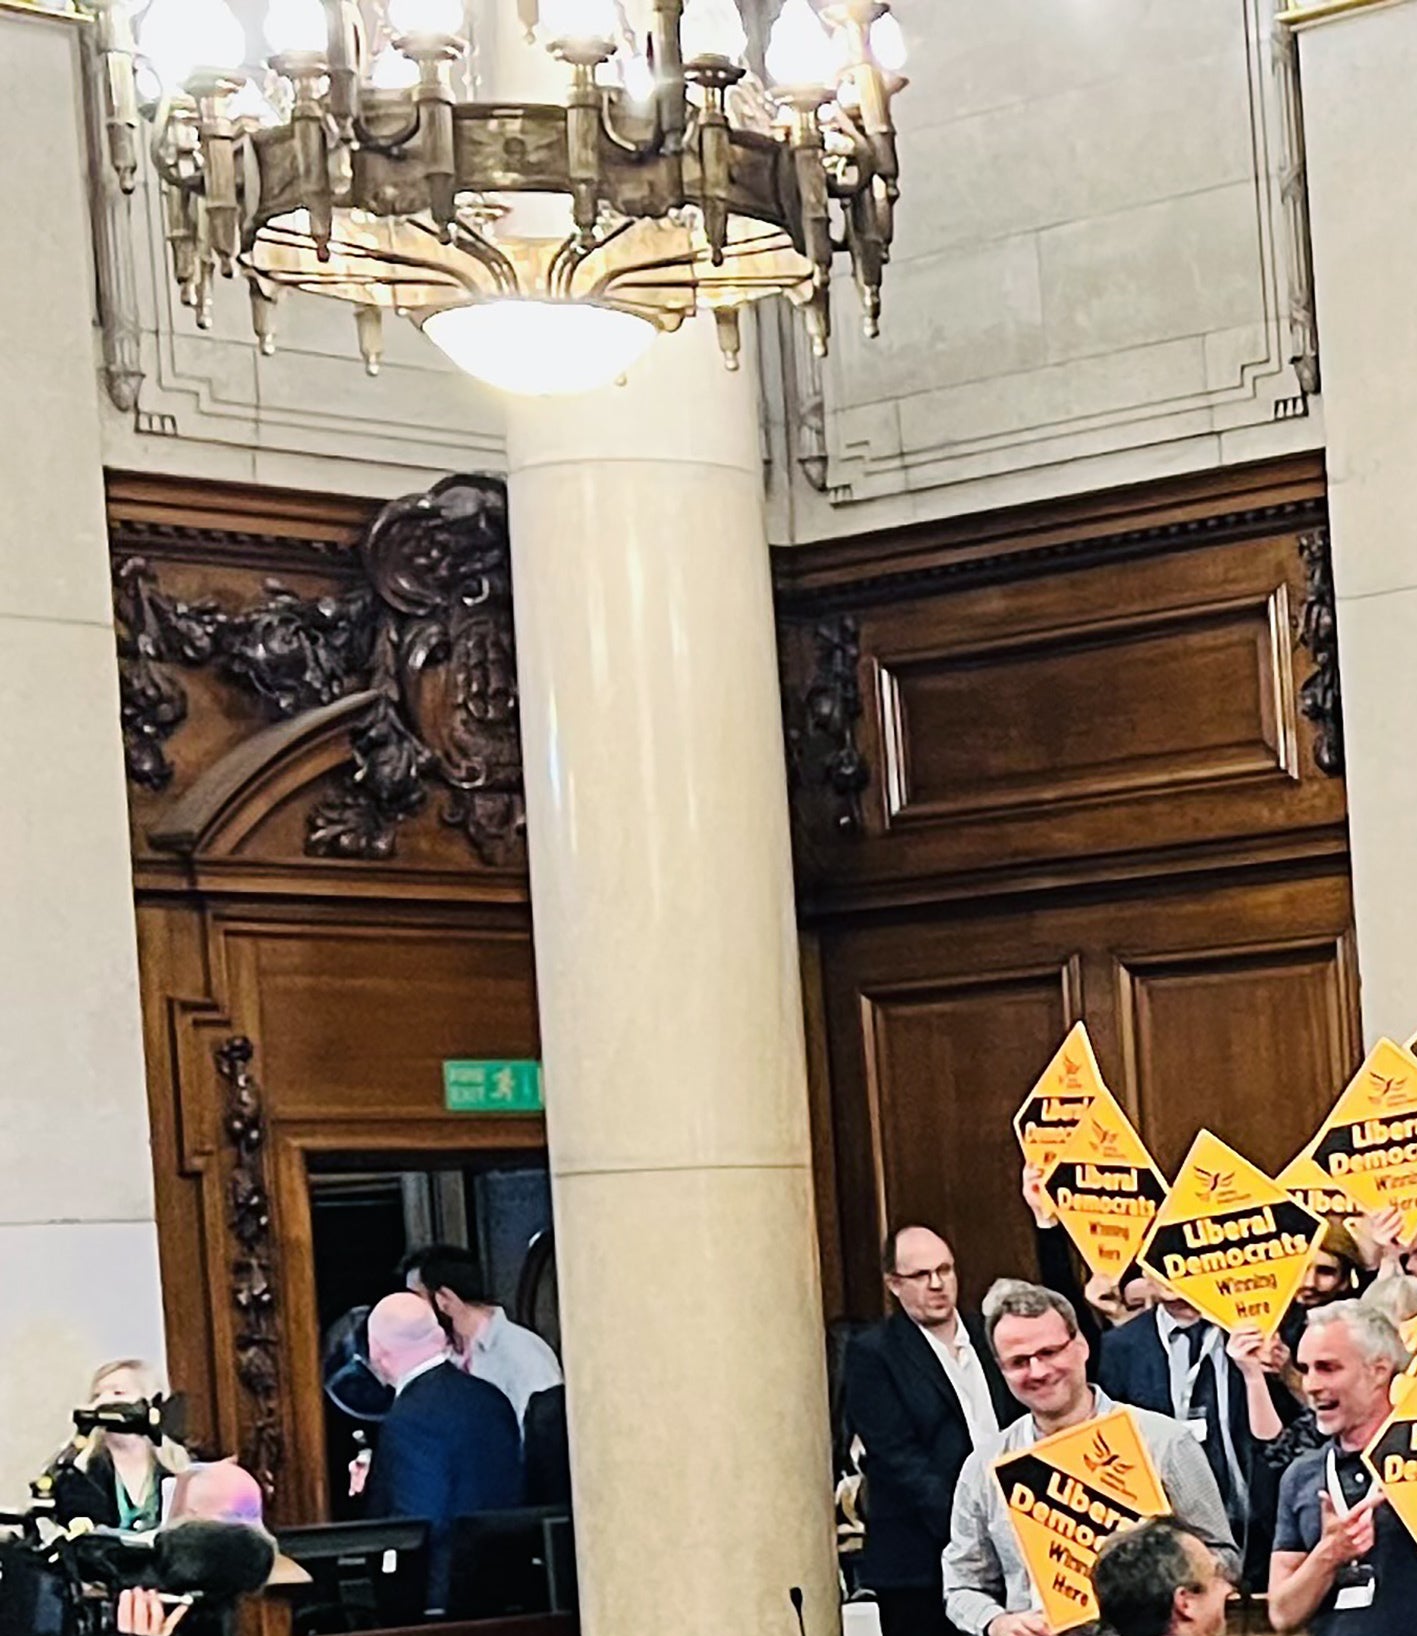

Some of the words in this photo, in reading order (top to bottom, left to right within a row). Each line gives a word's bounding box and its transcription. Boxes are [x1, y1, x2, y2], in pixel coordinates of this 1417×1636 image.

[1076, 1164, 1138, 1192] Liberal
[1183, 1205, 1277, 1249] Liberal
[1163, 1232, 1309, 1280] Democrats
[1216, 1272, 1277, 1296] Winning
[1235, 1300, 1270, 1318] Here
[1052, 1572, 1088, 1607] Here
